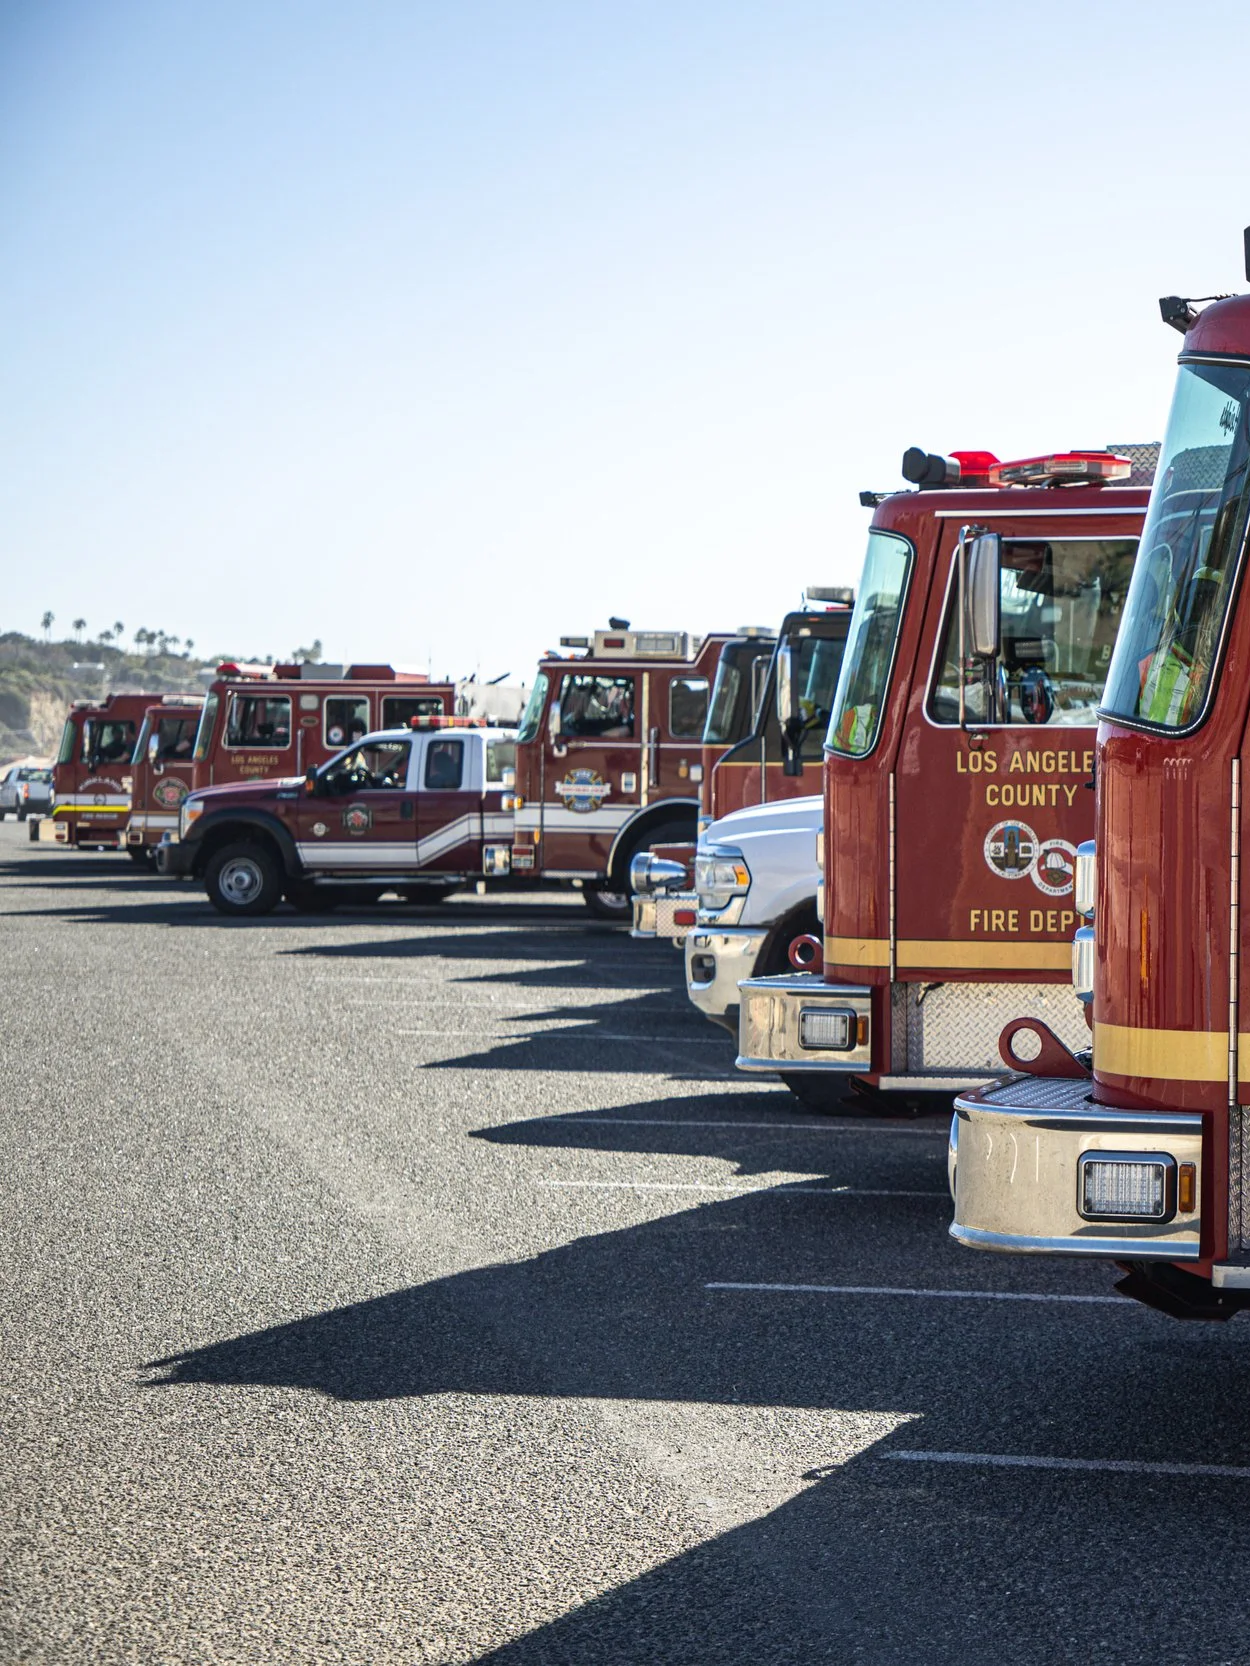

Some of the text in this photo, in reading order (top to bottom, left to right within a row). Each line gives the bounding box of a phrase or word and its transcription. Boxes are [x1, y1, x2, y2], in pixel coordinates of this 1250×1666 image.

[231, 755, 279, 766] LOS ANGELES
[956, 751, 1095, 773] LOS ANGELE
[239, 765, 269, 774] COUNTY
[986, 784, 1078, 807] COUNTY
[1038, 881, 1074, 894] DEPARTMEN
[970, 909, 1019, 932] FIRE
